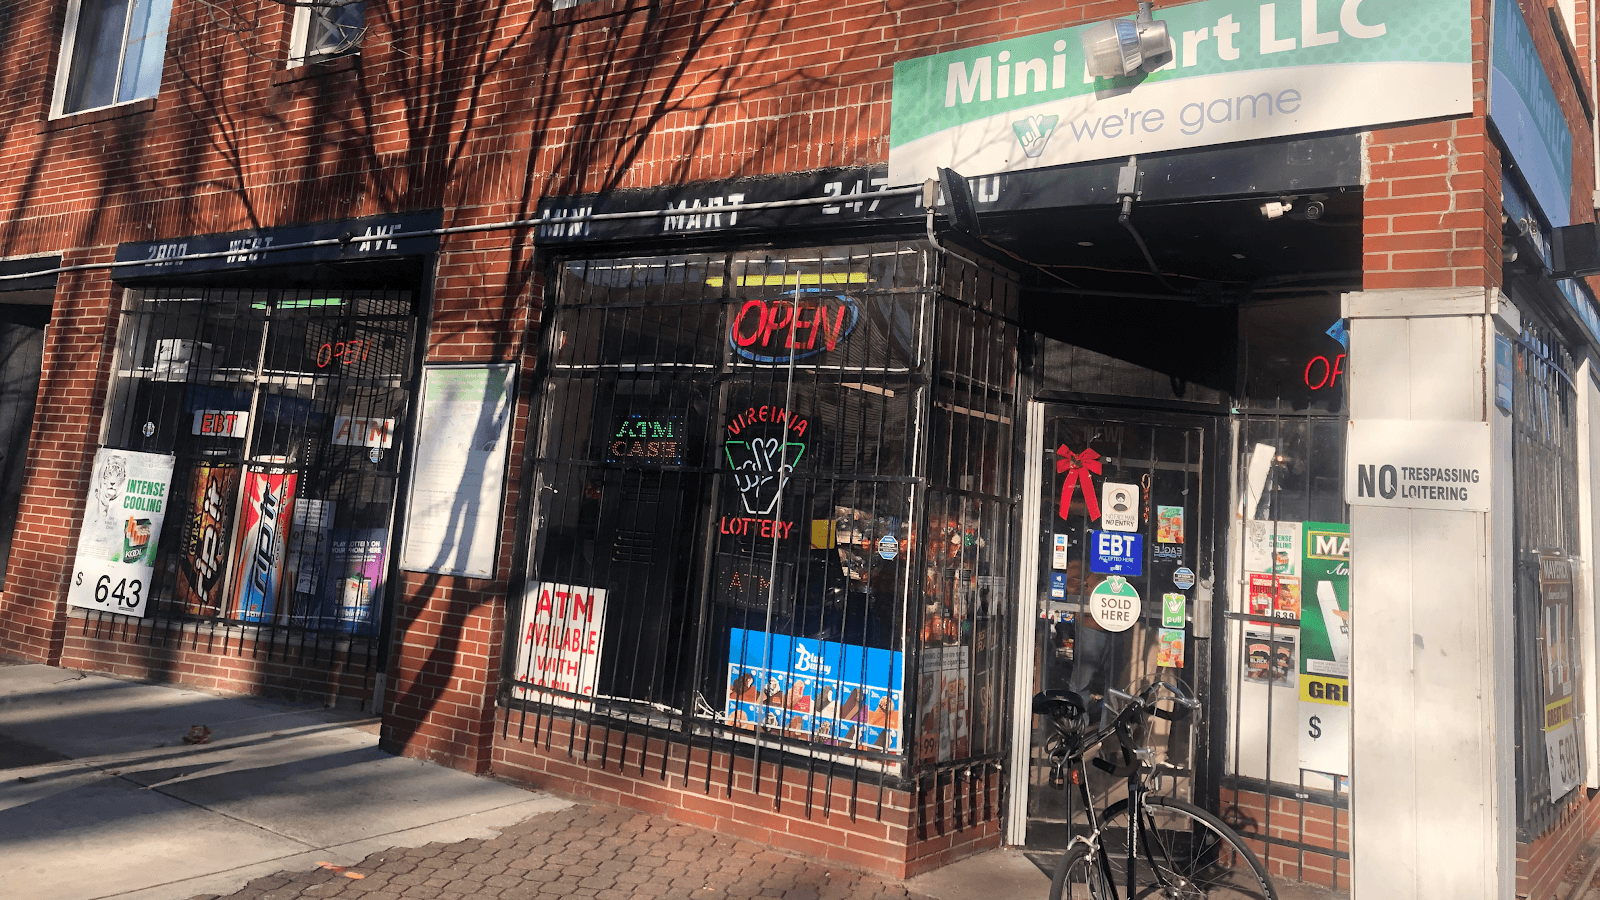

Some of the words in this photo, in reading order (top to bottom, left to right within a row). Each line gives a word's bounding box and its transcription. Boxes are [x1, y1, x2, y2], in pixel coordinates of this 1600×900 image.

[945, 41, 1067, 107] Mini
[1083, 14, 1240, 84] rt
[1259, 0, 1388, 53] LLC
[1070, 104, 1165, 143] we're
[1179, 88, 1302, 136] game
[664, 193, 746, 231] MART
[358, 223, 402, 252] AVE
[732, 299, 846, 351] OPEN
[316, 338, 373, 368] OPEN
[201, 413, 238, 435] EBT
[336, 419, 390, 443] ATM
[615, 420, 675, 439] ATM
[611, 441, 678, 459] CASH
[126, 478, 166, 497] INTENSE
[1357, 464, 1398, 500] NO
[1401, 466, 1480, 484] TRESPASSING
[1401, 484, 1468, 502] LOITERING
[123, 495, 163, 513] COOLING
[720, 516, 794, 540] LOTTERY
[124, 548, 142, 559] KOOL
[1099, 533, 1135, 557] EBT
[75, 571, 84, 587] $
[94, 574, 143, 608] 6.43
[728, 571, 772, 596] ATM
[536, 588, 595, 623] ATM
[1101, 598, 1131, 609] SOLD
[1101, 609, 1130, 622] HERE
[1166, 616, 1183, 624] pull
[525, 621, 597, 656] AVAILABLE
[536, 655, 579, 678] WITH
[1249, 657, 1268, 665] BLACK
[550, 679, 593, 704] BILS
[1308, 714, 1322, 741] $
